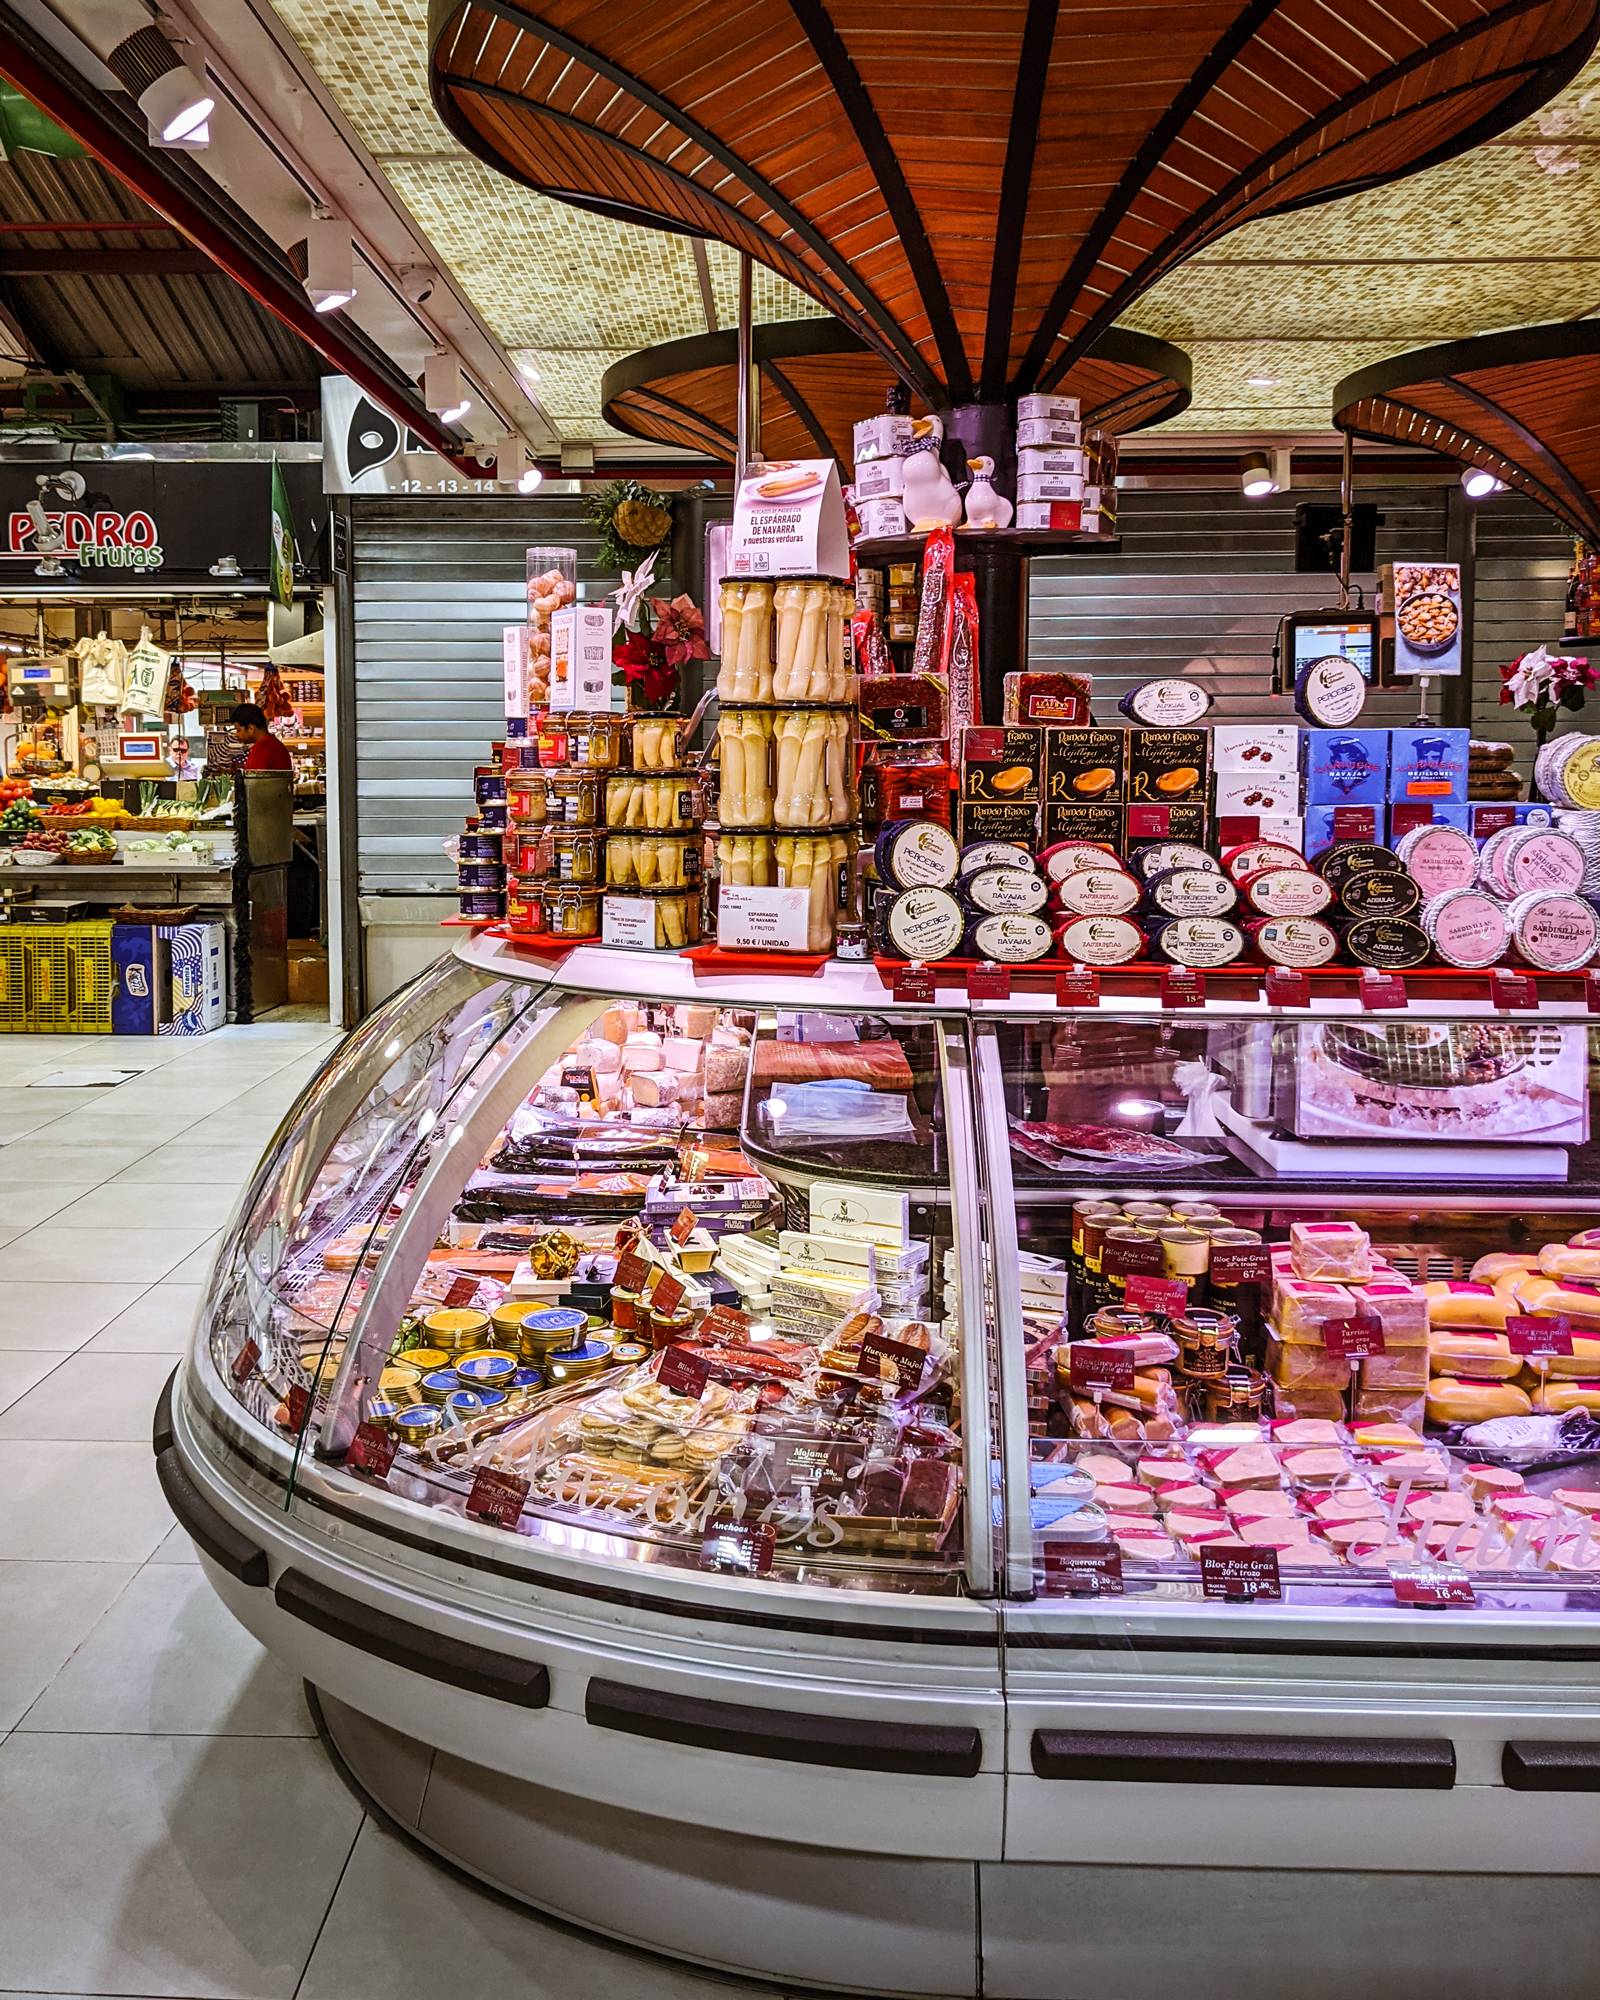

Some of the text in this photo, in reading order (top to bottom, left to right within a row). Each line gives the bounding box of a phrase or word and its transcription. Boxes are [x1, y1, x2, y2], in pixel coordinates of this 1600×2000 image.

[401, 480, 495, 493] 12 13 14
[750, 512, 802, 525] EL ESPÁRRAGO
[752, 525, 795, 535] DE NAVARRA
[748, 537, 775, 545] nuestras
[776, 534, 804, 543] verduras
[79, 542, 164, 567] Frutas
[1316, 682, 1356, 704] PERCEBES
[968, 770, 995, 799] R
[1049, 771, 1076, 800] R
[1132, 771, 1159, 800] R
[904, 848, 945, 872] PERCEBES
[902, 914, 950, 936] PERCEBES
[1533, 925, 1584, 935] SARDINILLAS
[1123, 1250, 1138, 1259] Foie
[1141, 1253, 1159, 1262] Gras
[864, 1345, 888, 1358] Hueva
[900, 1357, 922, 1370] Mujol
[794, 1448, 829, 1459] Mojama
[496, 1487, 505, 1495] de
[712, 1521, 748, 1532] Anchoas
[1205, 1560, 1274, 1570] Bloc Foie Gras
